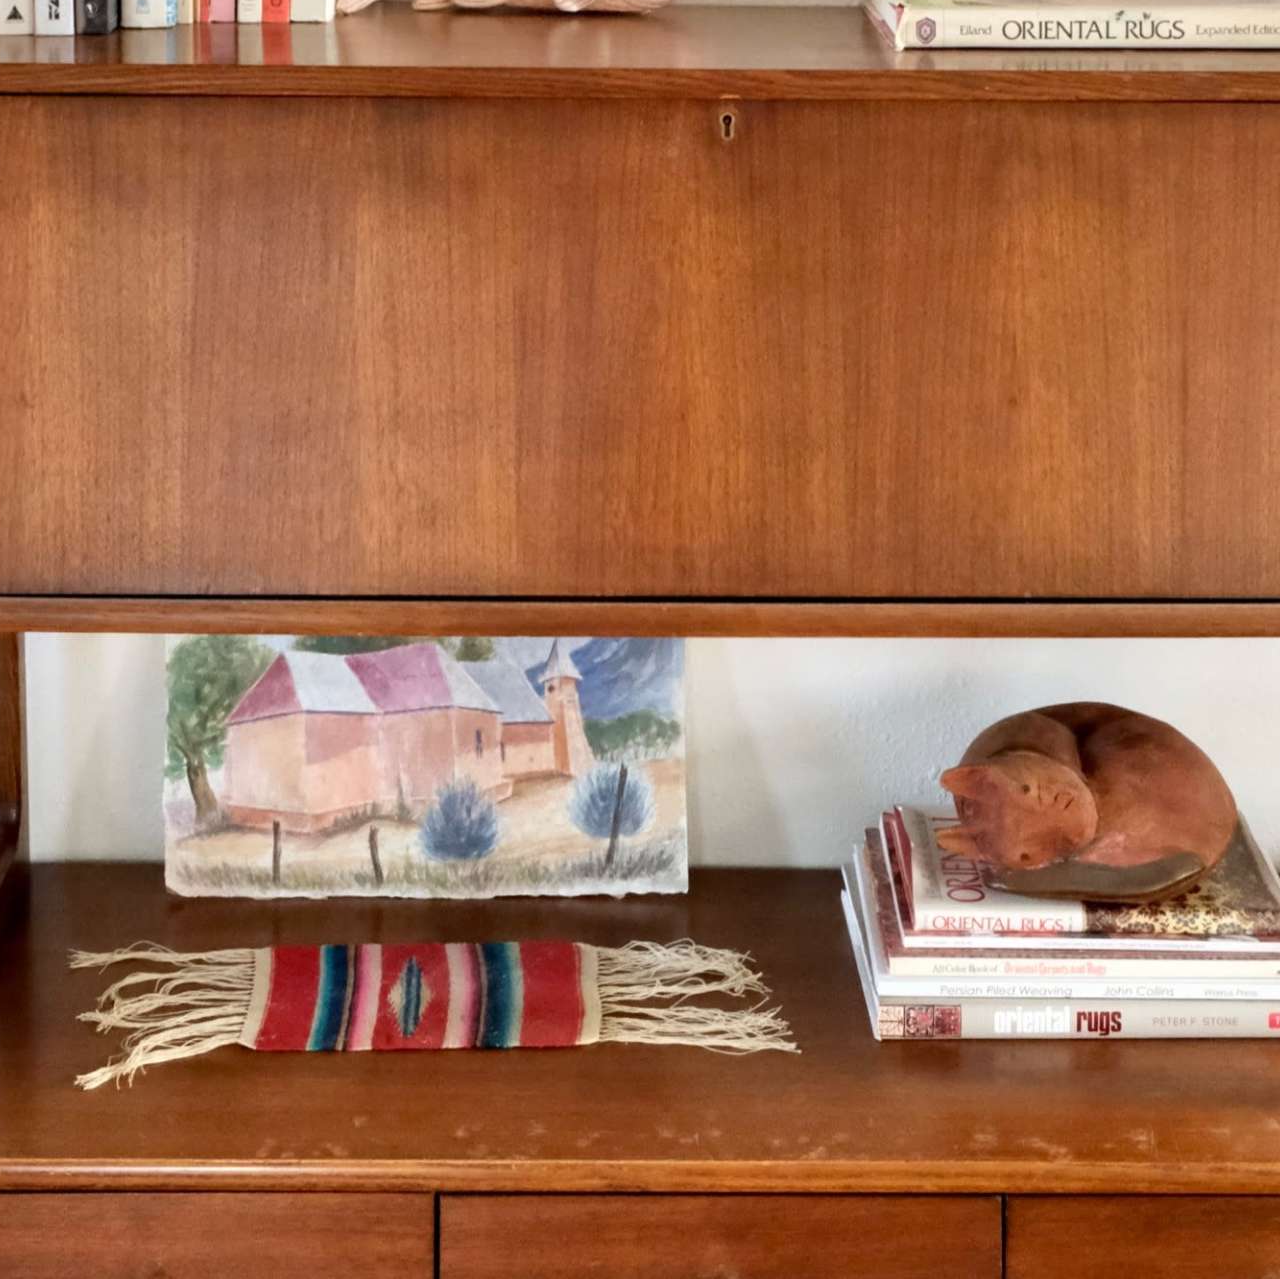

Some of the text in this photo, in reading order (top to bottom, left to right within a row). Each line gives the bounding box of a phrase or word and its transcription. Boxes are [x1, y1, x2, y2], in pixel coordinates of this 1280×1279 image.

[959, 23, 993, 37] Eiland
[1002, 19, 1118, 41] ORIENTAL
[1124, 19, 1186, 40] RUGS
[1195, 23, 1251, 39] Expanded
[932, 915, 1065, 932] ORIENTAL RUGS
[939, 984, 1175, 998] Persian Piled Weaving John Collins
[993, 1005, 1122, 1037] oriental rugs
[1152, 1016, 1186, 1026] PETER
[1201, 1016, 1239, 1026] STONE
